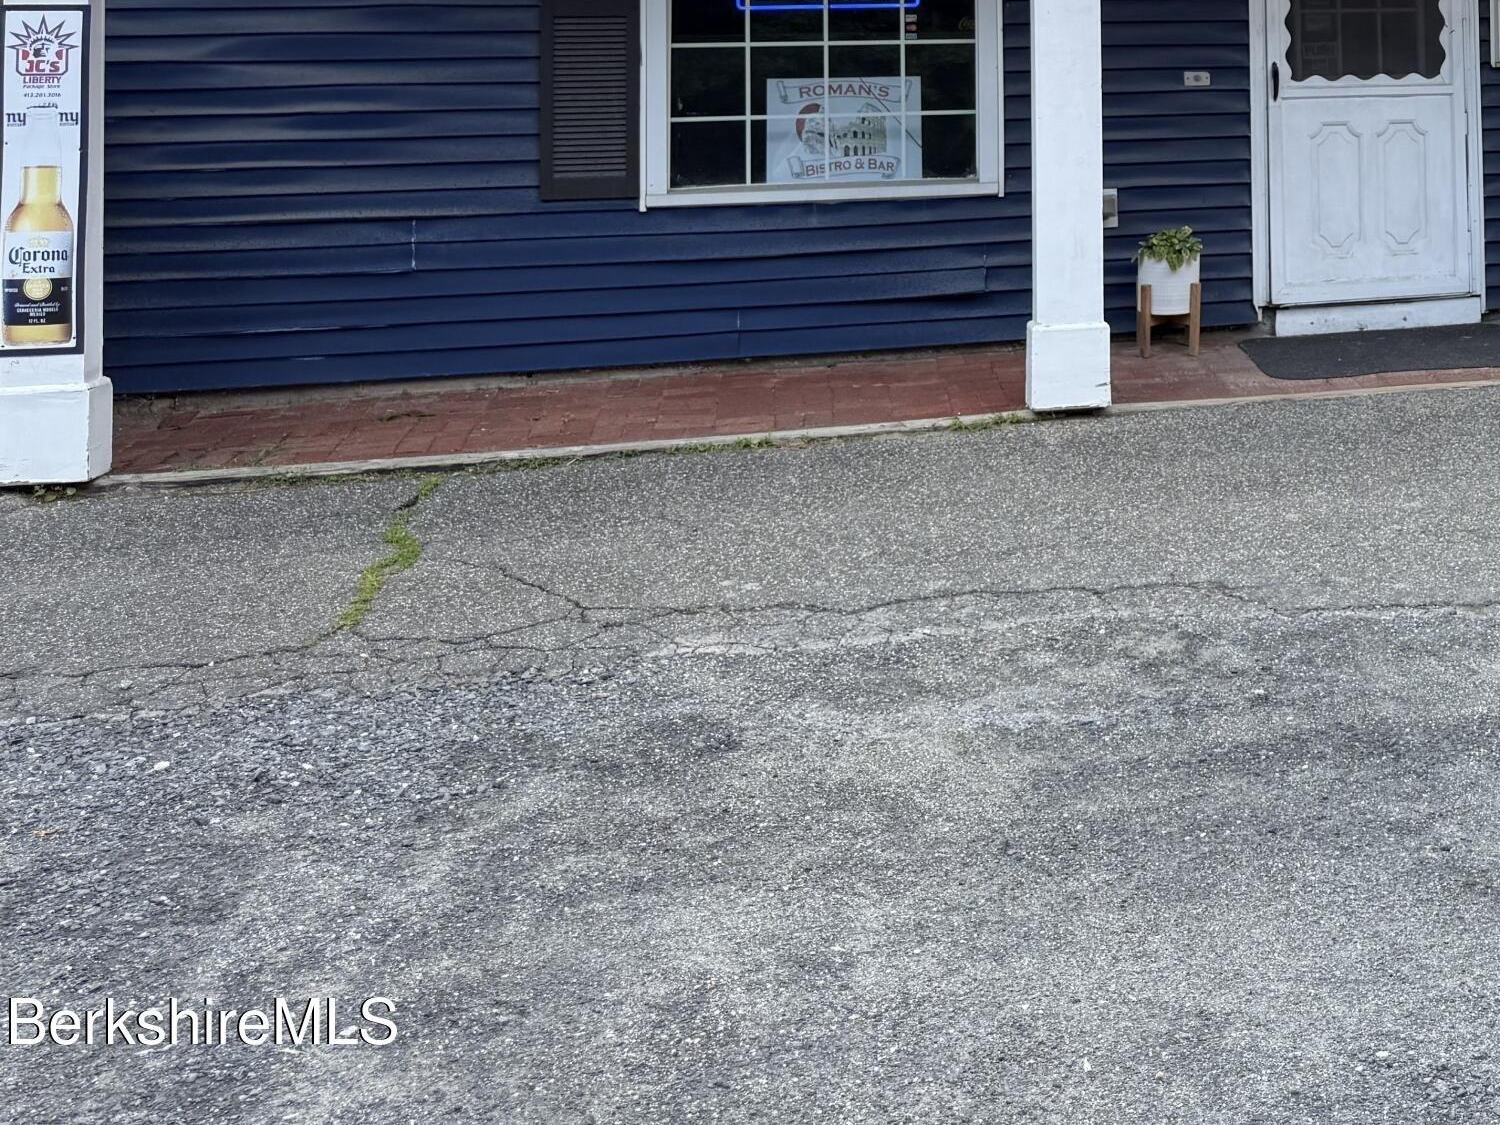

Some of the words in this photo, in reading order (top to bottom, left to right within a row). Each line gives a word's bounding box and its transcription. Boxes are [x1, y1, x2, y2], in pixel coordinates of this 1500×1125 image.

[23, 76, 61, 84] LIBERTY
[800, 83, 889, 98] ROMAN'S
[855, 158, 865, 170] &
[868, 158, 895, 172] BAR
[8, 246, 68, 267] Corona
[22, 262, 55, 274] Extra
